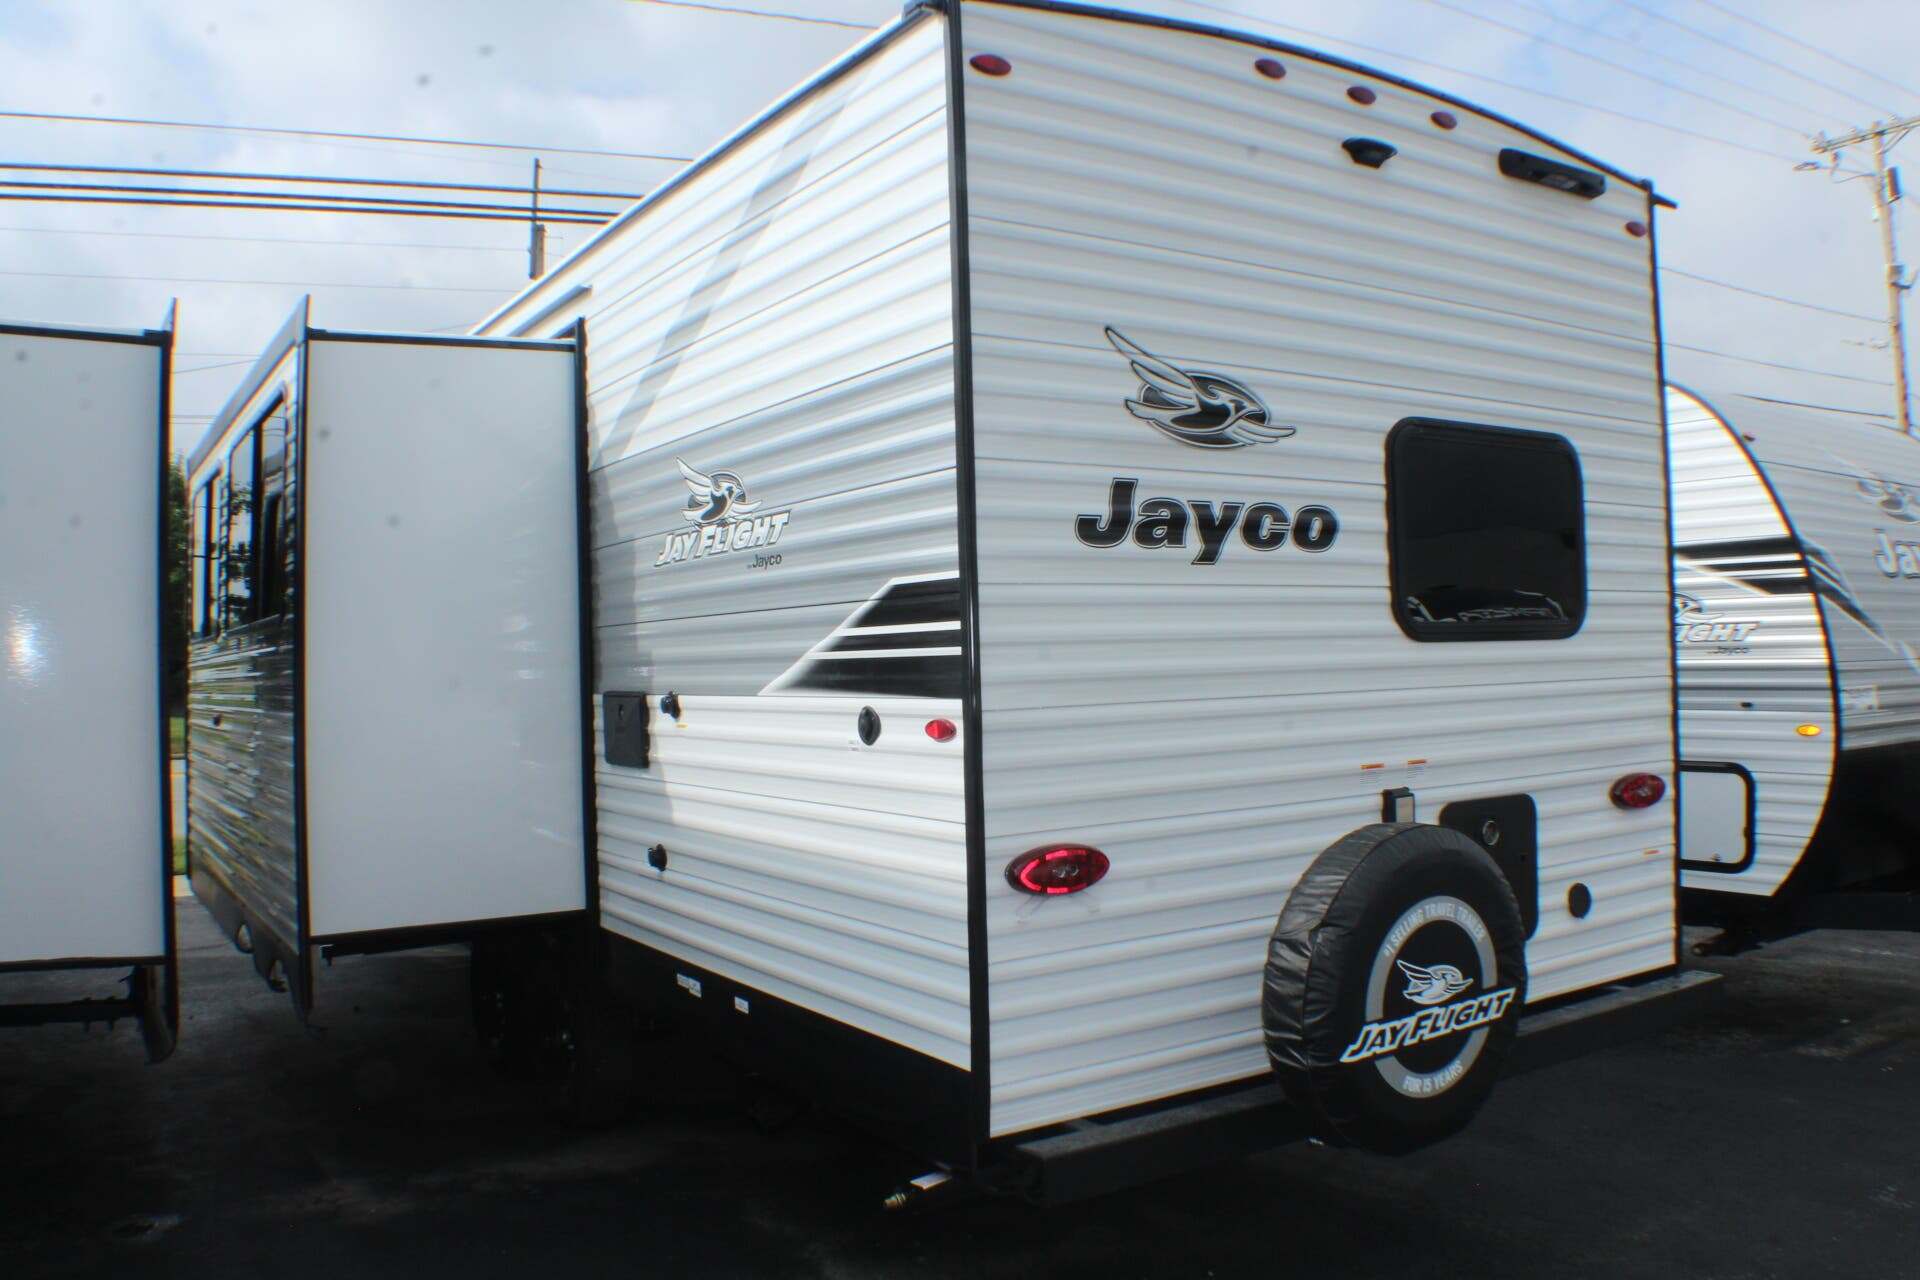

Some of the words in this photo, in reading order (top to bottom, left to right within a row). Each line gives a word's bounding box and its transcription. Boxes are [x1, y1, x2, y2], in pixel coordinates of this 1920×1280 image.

[1074, 476, 1340, 565] Jayco
[752, 553, 783, 570] Jayco
[1674, 622, 1758, 642] IGHT
[1424, 902, 1457, 919] TRAVEL
